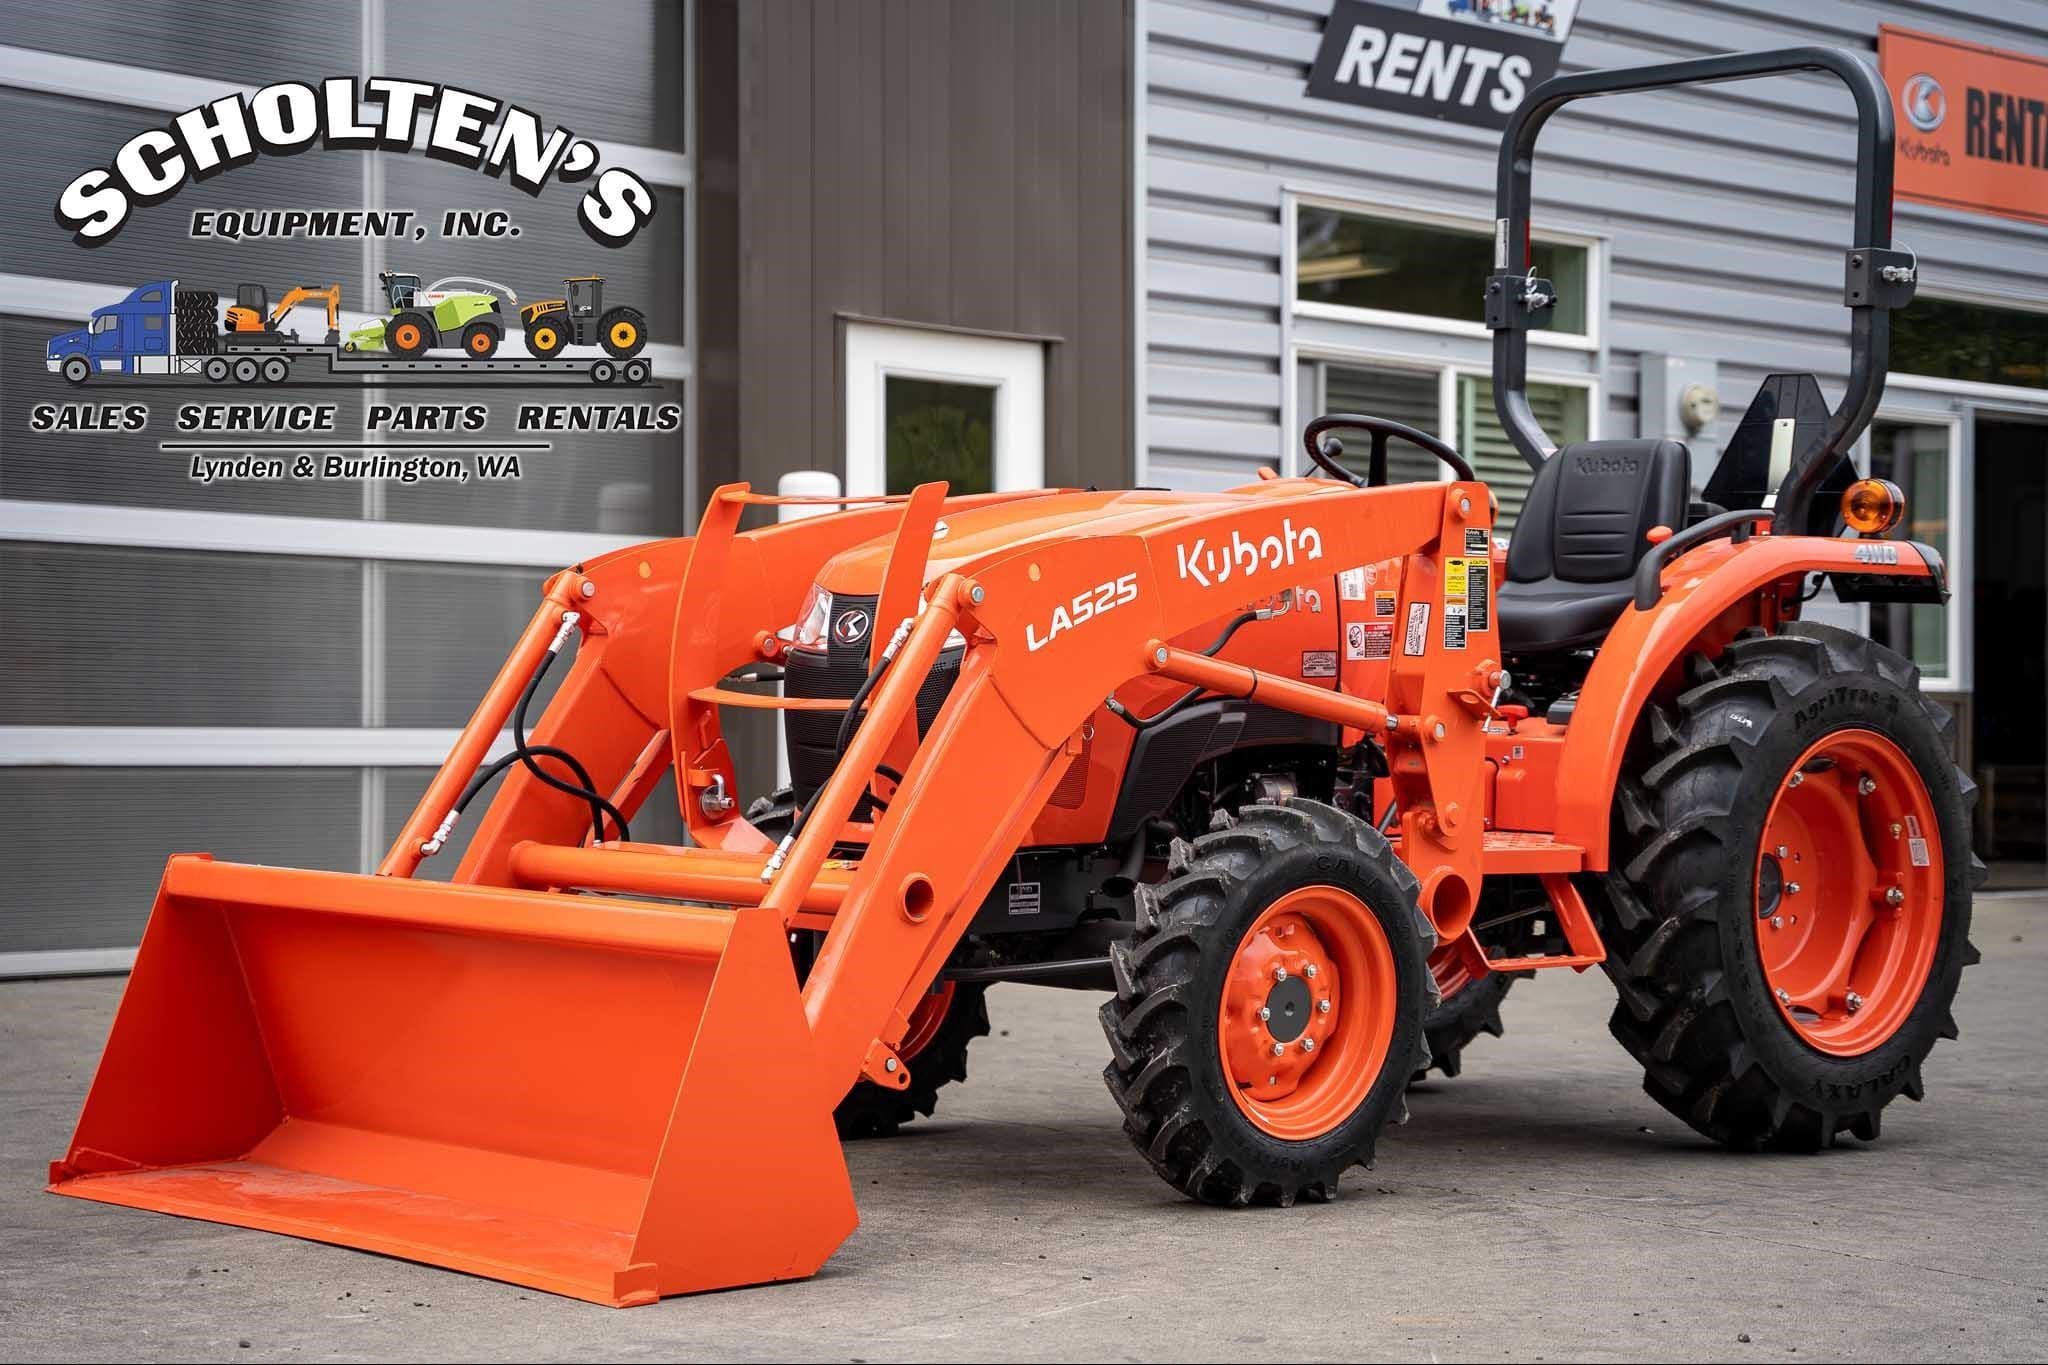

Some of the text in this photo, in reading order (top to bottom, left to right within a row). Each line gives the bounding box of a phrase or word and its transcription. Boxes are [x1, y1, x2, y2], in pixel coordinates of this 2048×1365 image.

[1335, 25, 1531, 114] RENTS
[1966, 86, 2048, 170] RENT
[1176, 518, 1323, 587] Kubota
[1855, 544, 1897, 565] 4WD
[1025, 572, 1138, 652] LA525
